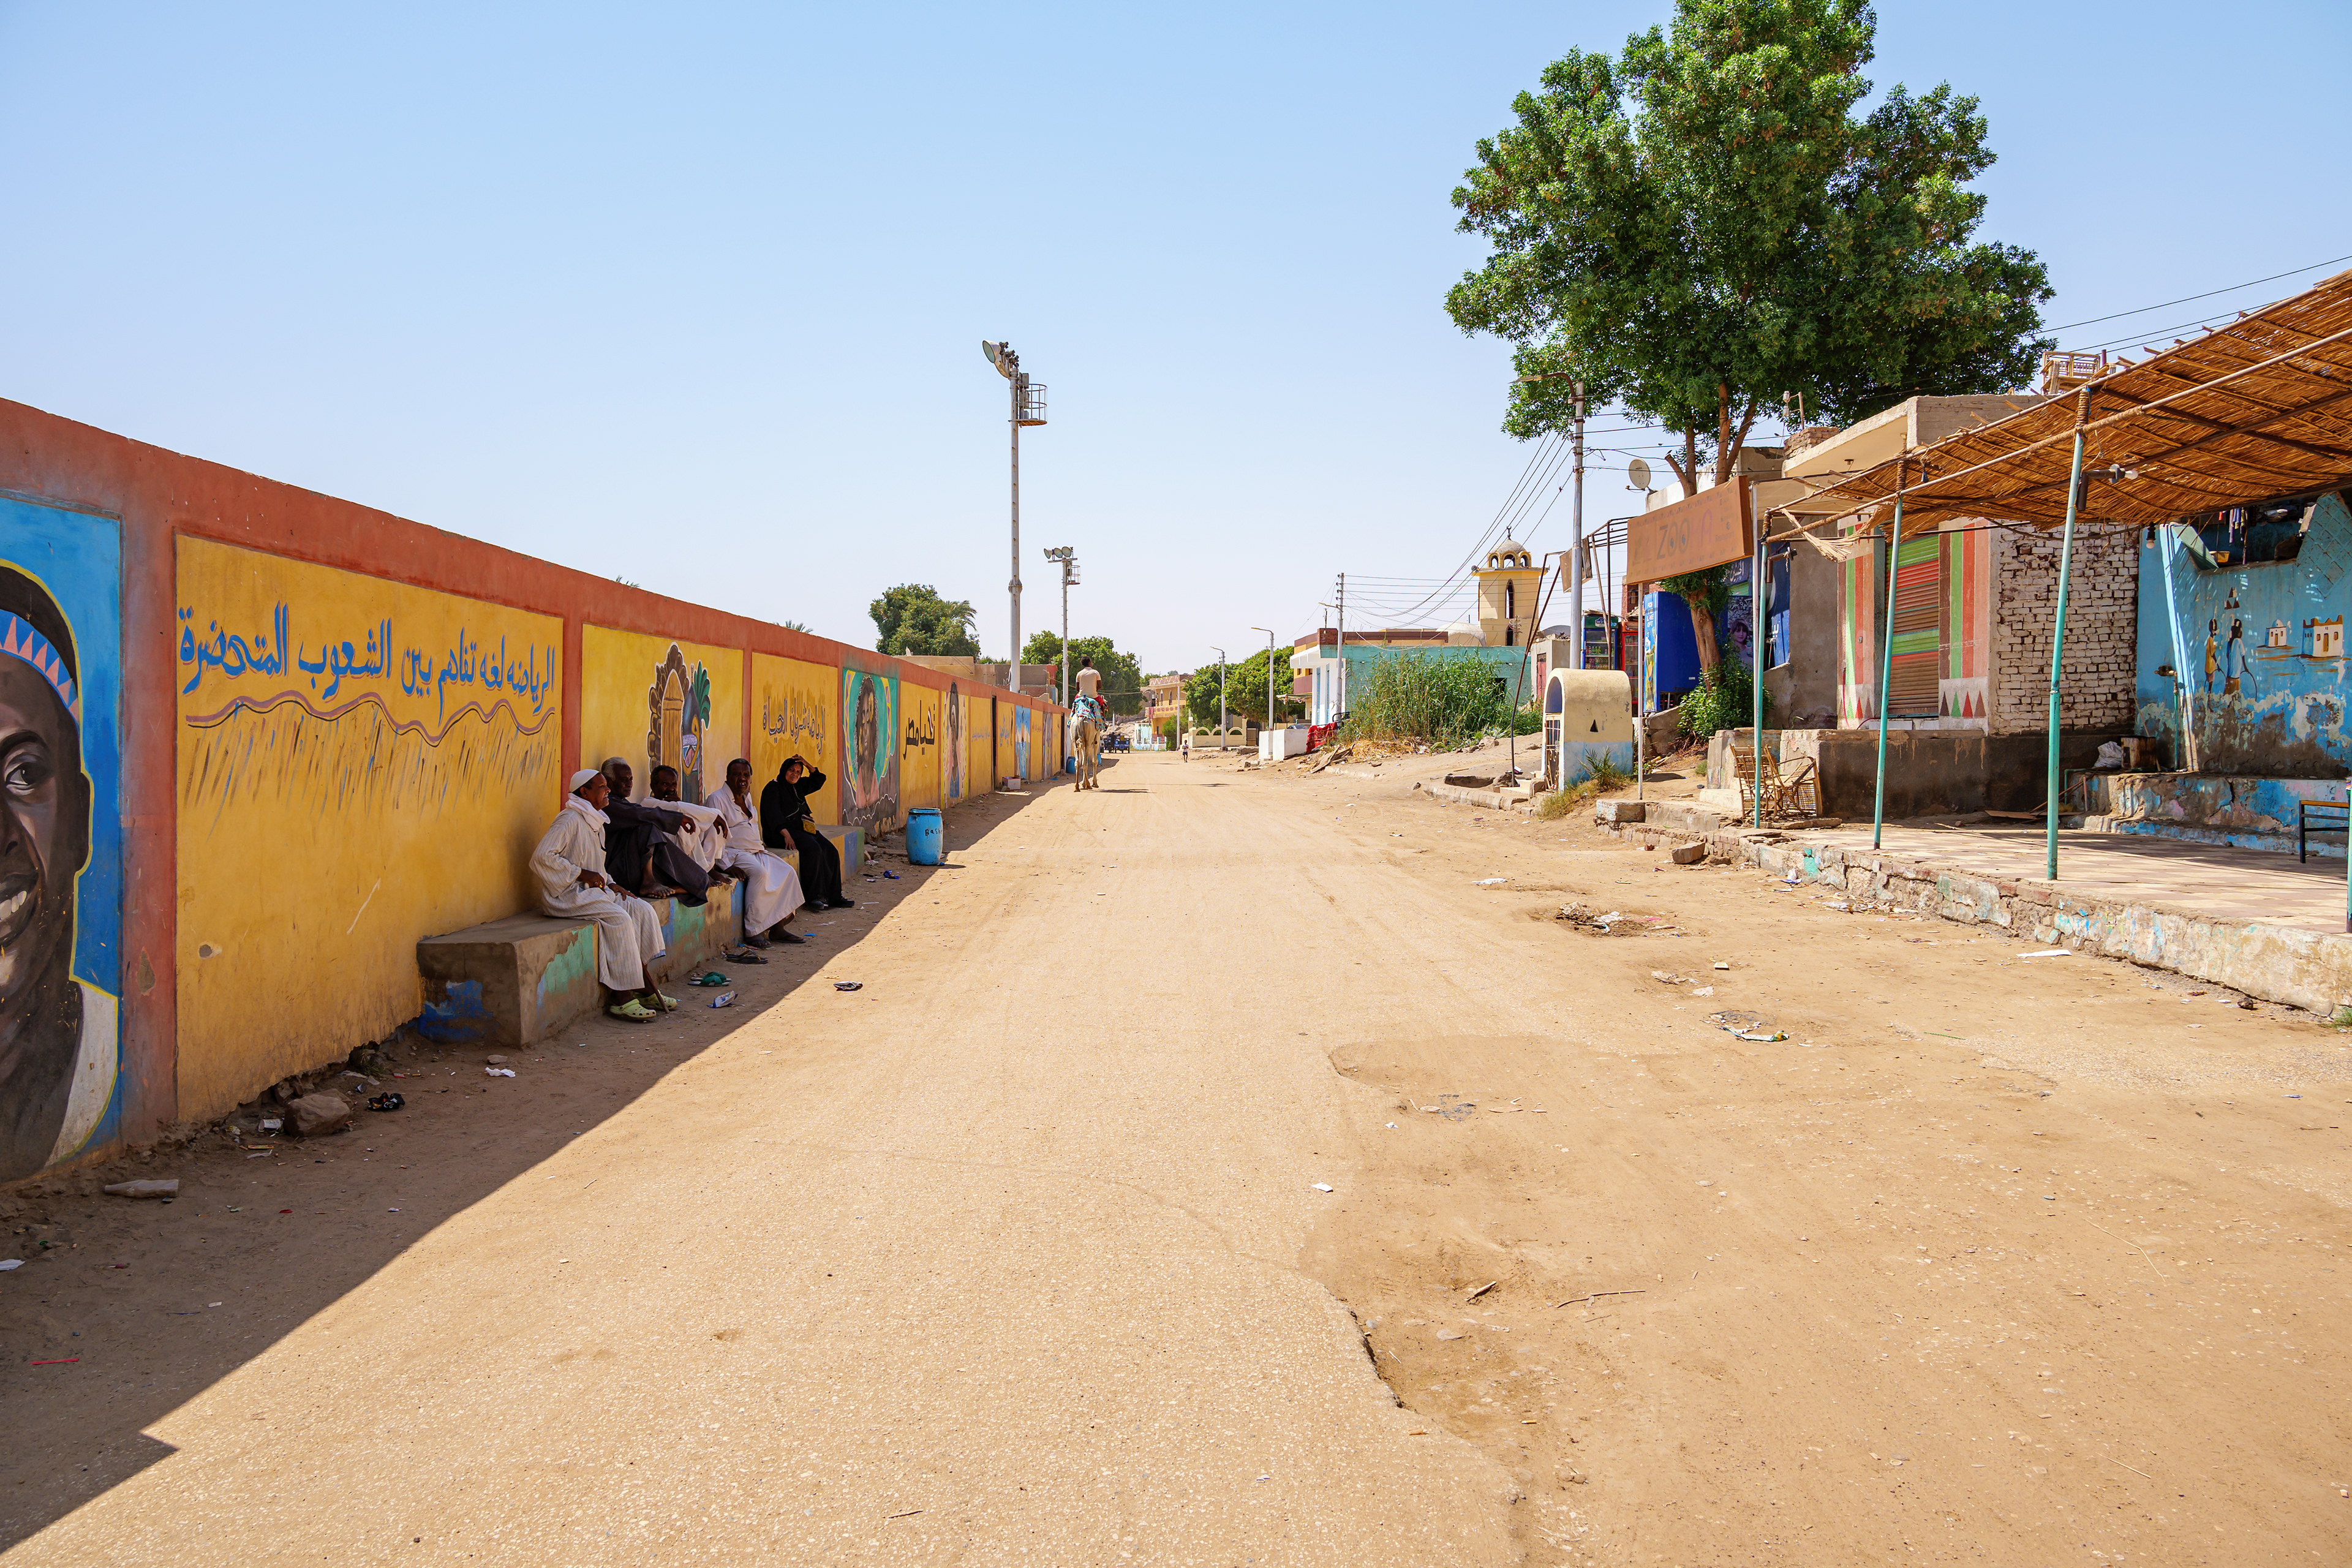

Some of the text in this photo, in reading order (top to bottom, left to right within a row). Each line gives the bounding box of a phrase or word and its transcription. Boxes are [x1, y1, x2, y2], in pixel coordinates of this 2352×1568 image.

[178, 600, 290, 696] المتحضرة
[298, 617, 392, 703] الشعوب
[401, 646, 432, 698] بين
[438, 627, 477, 728] تفاهم
[763, 696, 787, 744] الحياة
[903, 699, 935, 760] تحيا مصر
